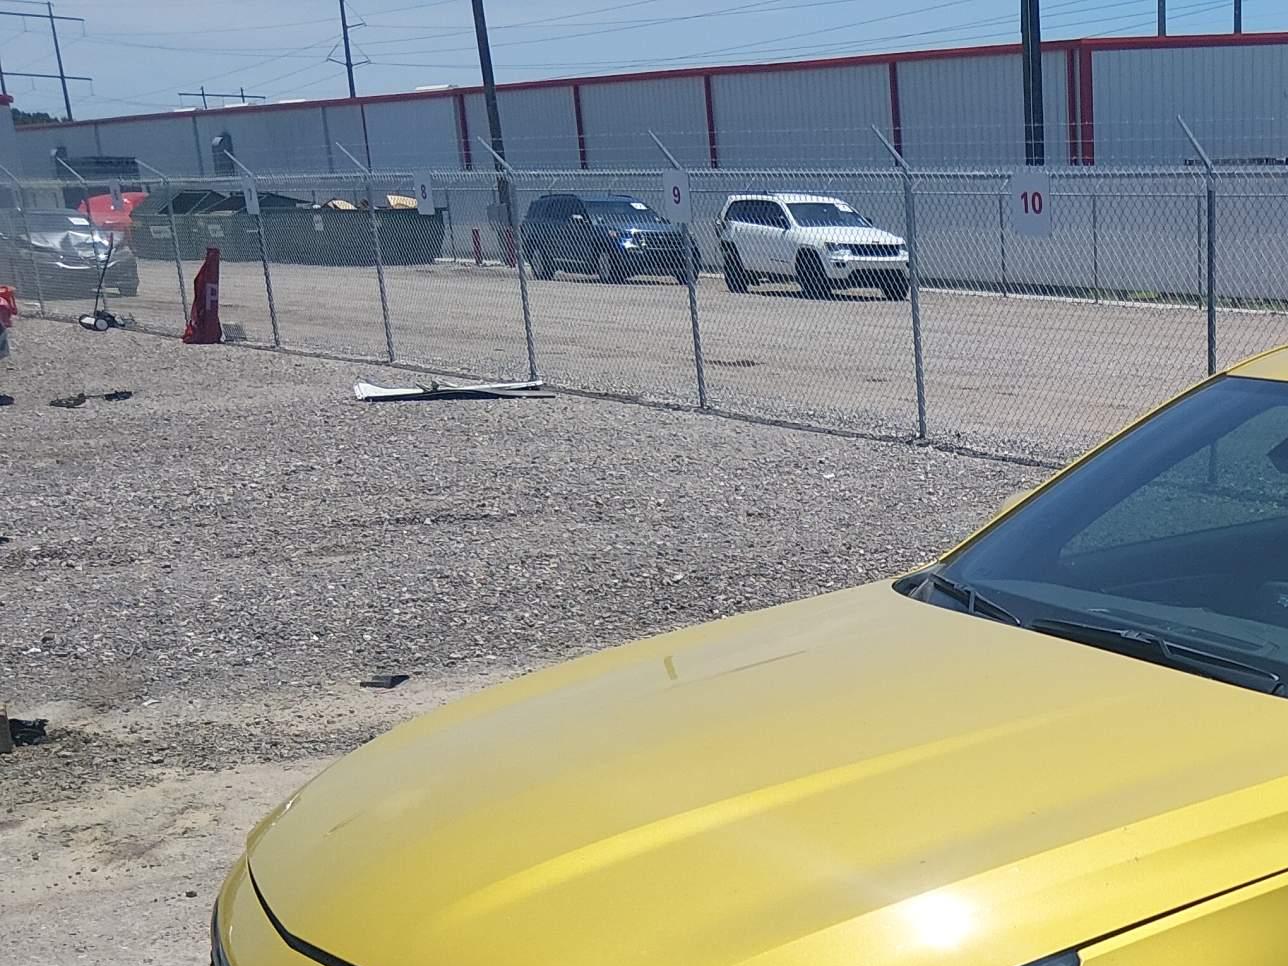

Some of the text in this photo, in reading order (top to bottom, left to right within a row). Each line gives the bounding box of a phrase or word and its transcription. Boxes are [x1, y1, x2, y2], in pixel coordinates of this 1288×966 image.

[420, 184, 427, 200] 8
[672, 186, 681, 204] 9
[1020, 191, 1043, 215] 10
